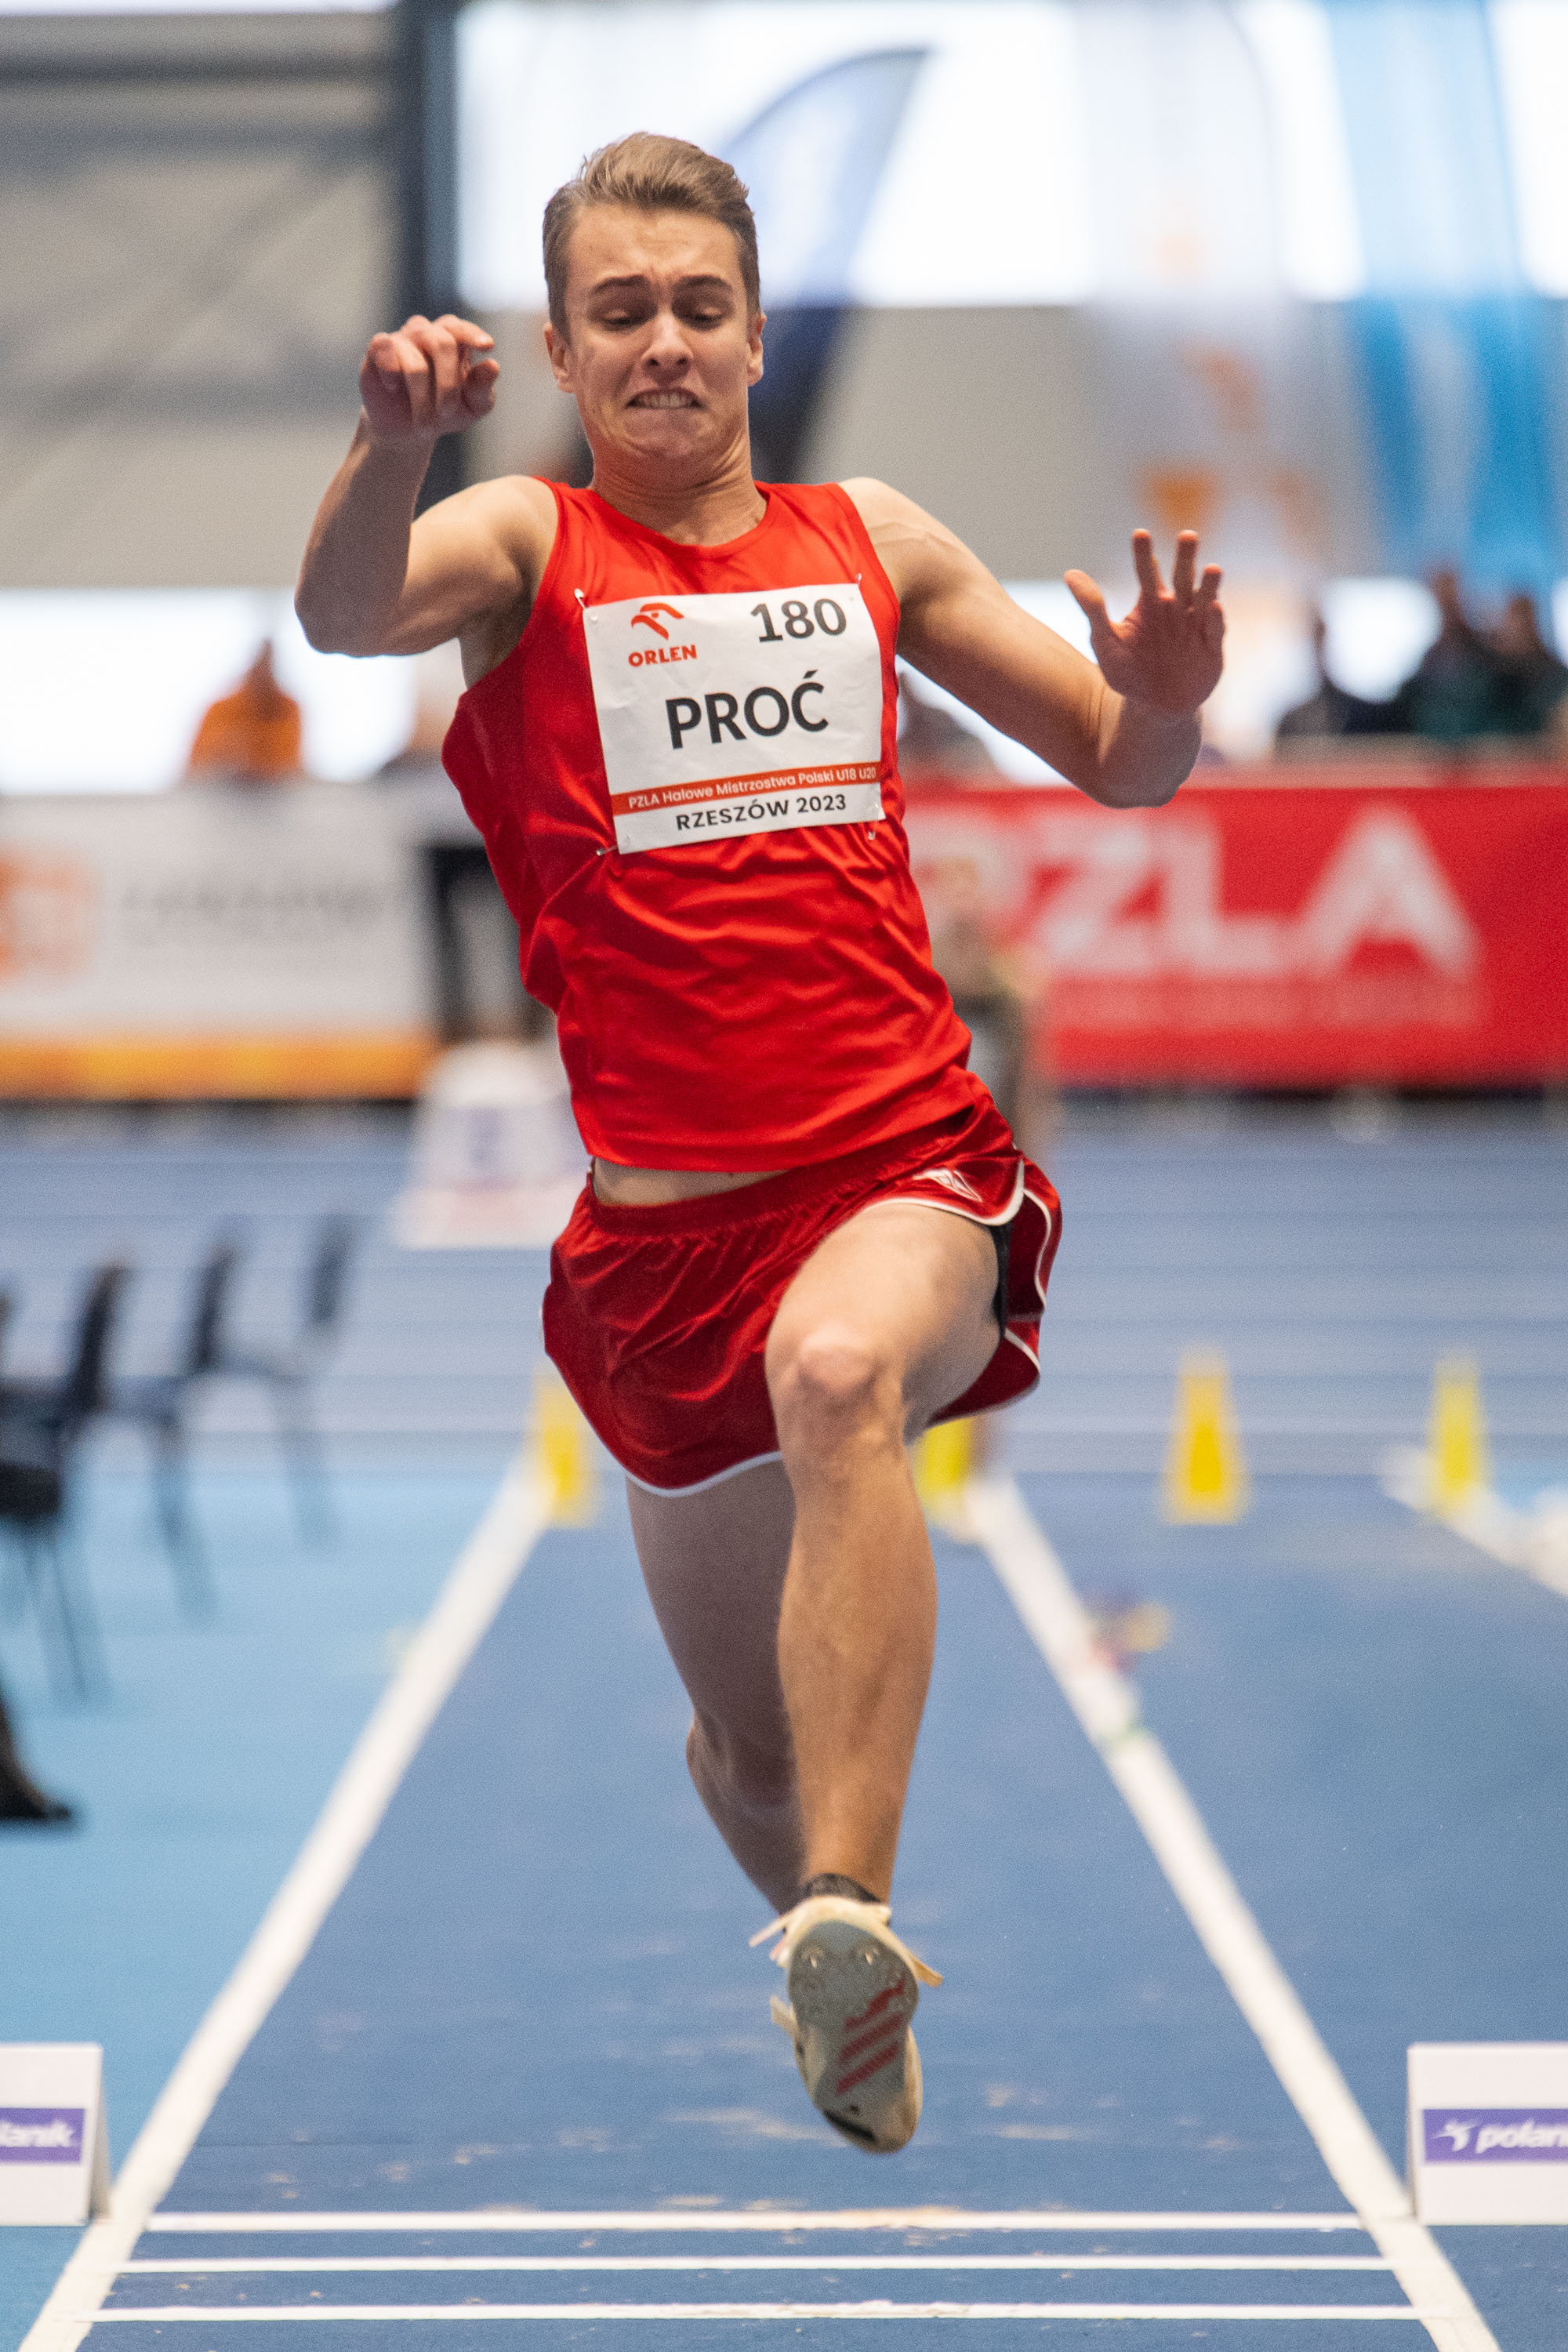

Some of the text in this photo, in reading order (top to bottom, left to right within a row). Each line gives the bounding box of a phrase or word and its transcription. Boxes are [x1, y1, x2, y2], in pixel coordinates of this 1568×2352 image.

[750, 598, 847, 643] 180
[629, 644, 697, 667] ORLEN
[665, 670, 829, 750] PROĆ
[629, 766, 877, 809] PZLA Halowe Mistrzostwa Polski U18 U20
[676, 793, 847, 830] RZESZÓW 2023
